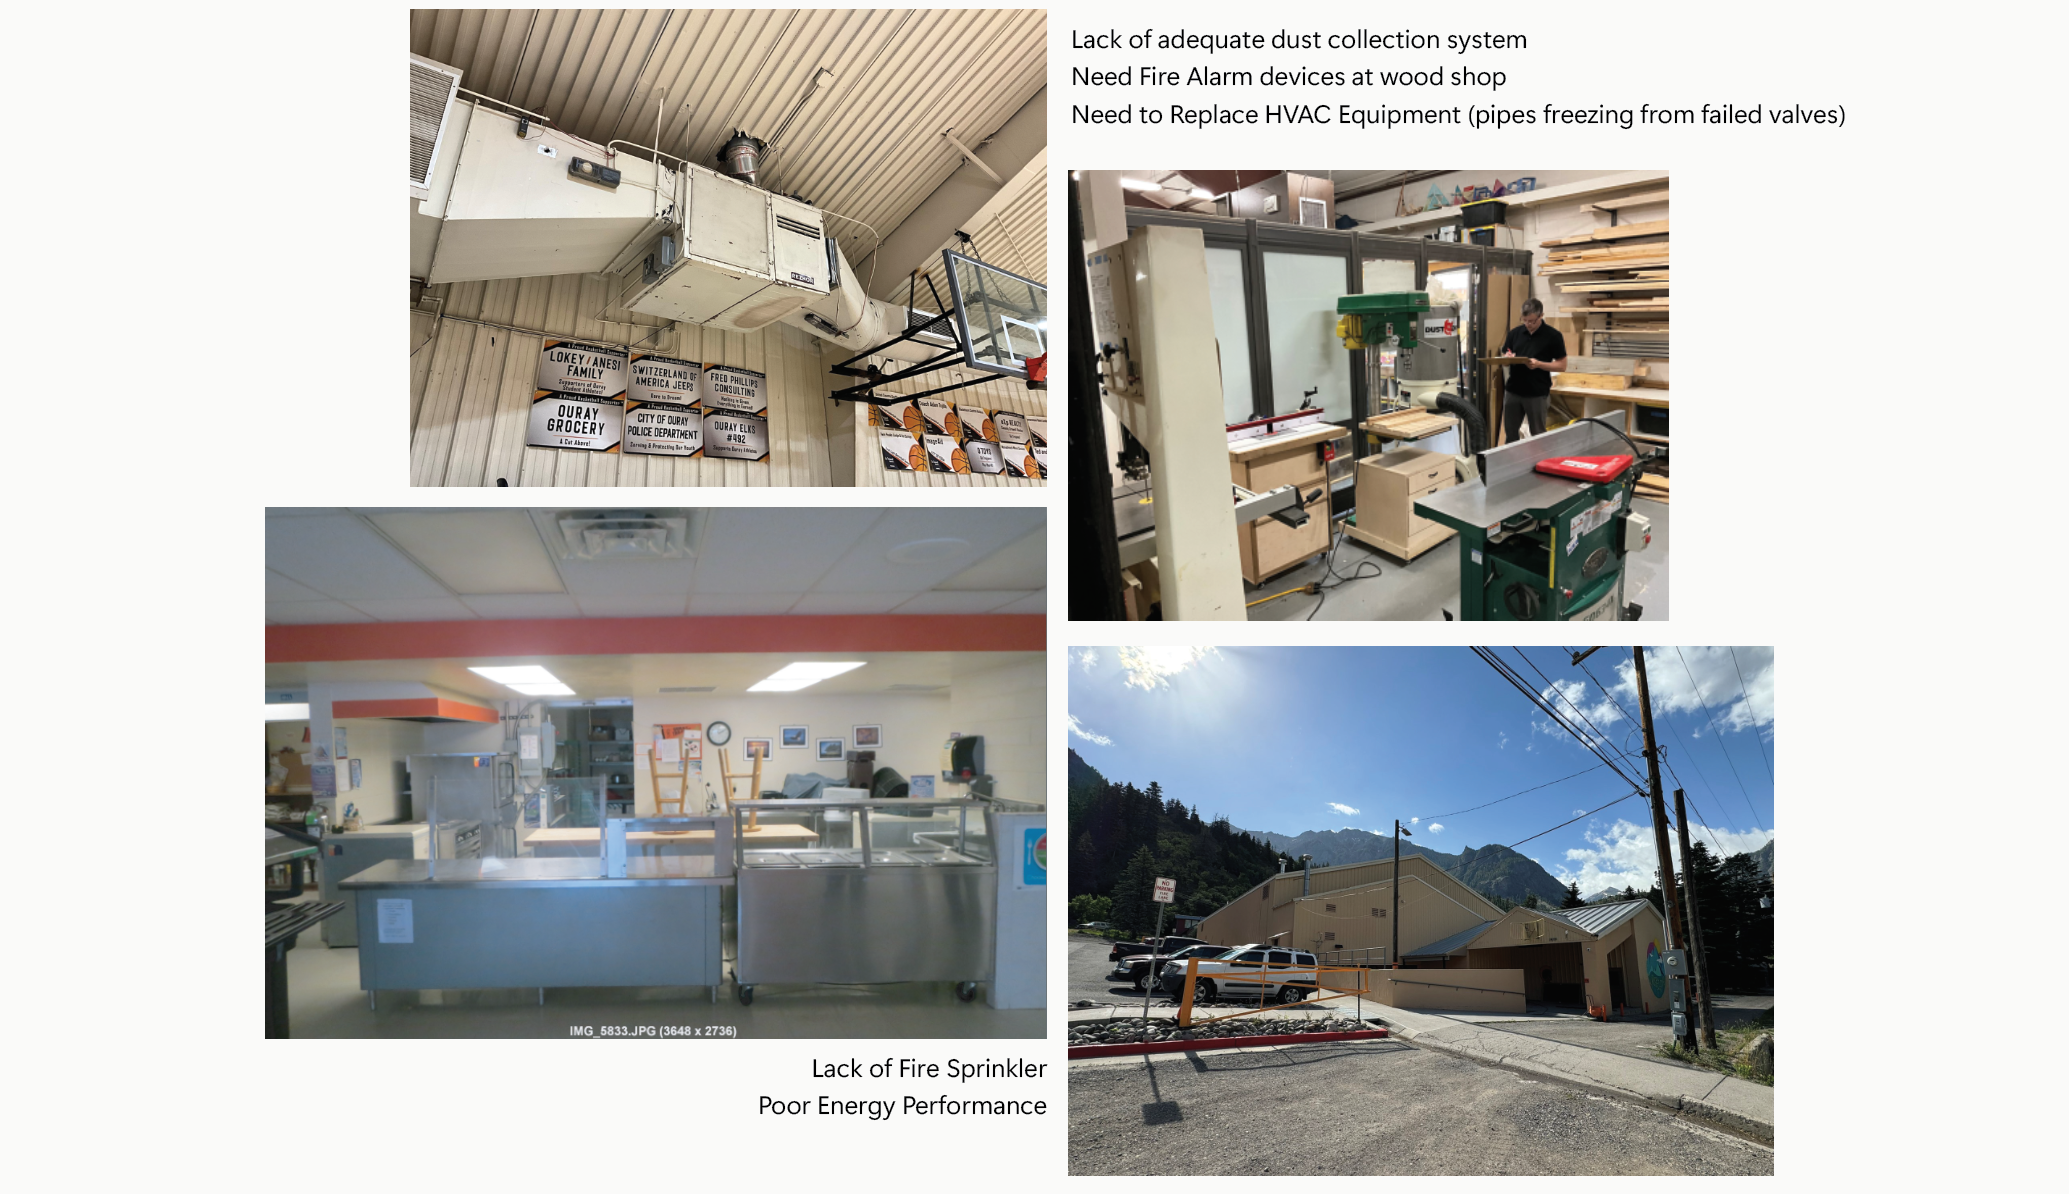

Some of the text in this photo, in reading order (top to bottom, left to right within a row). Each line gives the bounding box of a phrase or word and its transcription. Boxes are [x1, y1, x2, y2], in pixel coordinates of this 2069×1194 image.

[567, 365, 604, 379] FAMILY
[632, 365, 698, 381] SWITZERLAND OF
[559, 379, 585, 387] Supporters
[636, 377, 694, 392] AMERICA JEEPS
[710, 373, 758, 389] FRED PHILLIPS
[715, 384, 755, 398] CONSULTING
[558, 405, 599, 420] OURAY
[638, 413, 689, 426] CITY OF OURAY
[547, 418, 605, 436] GROCERY
[628, 426, 698, 440] POLICE DEPARTMENT
[714, 421, 756, 434] OURAY ELKS
[727, 434, 746, 444] #492
